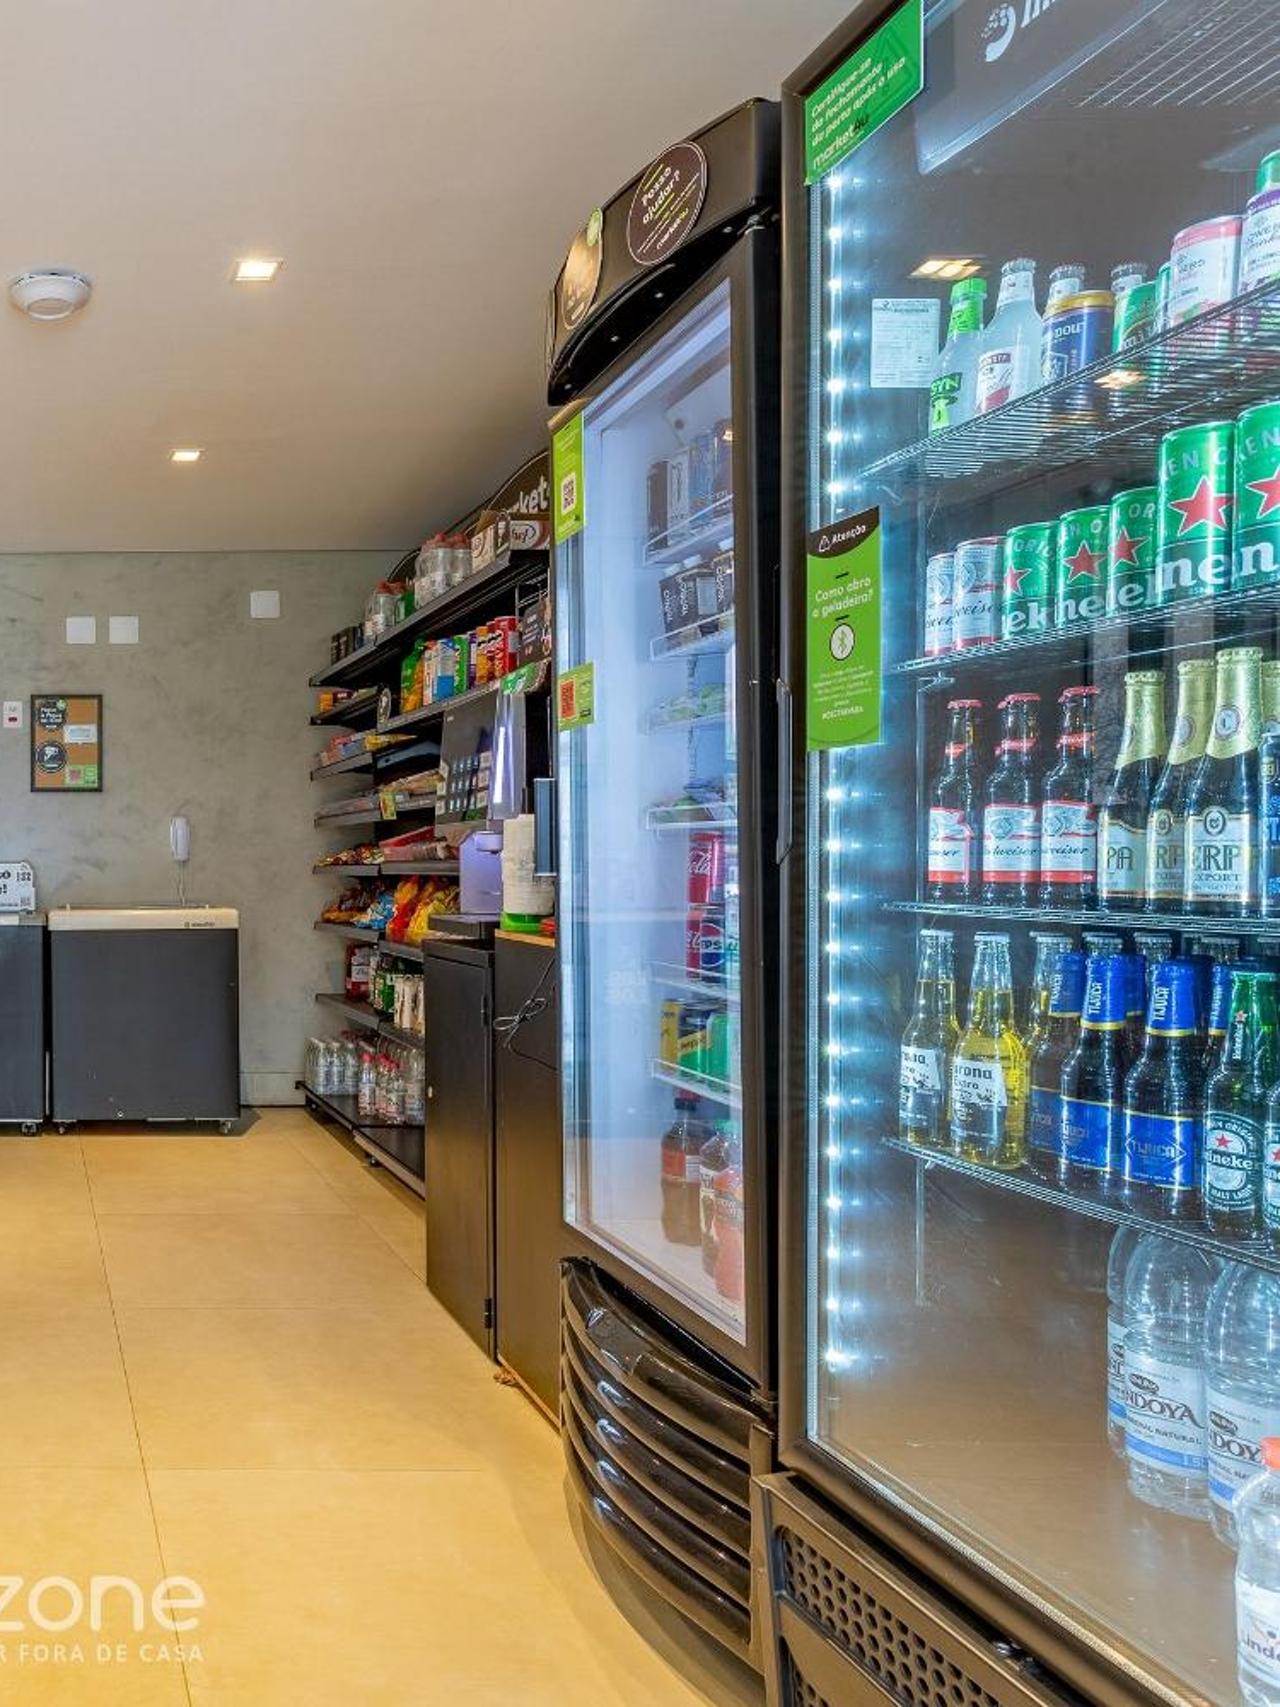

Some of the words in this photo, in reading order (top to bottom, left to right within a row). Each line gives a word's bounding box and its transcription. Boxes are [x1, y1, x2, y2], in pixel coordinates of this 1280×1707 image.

[831, 525, 867, 544] Atenção
[815, 586, 844, 602] Como
[1126, 1390, 1206, 1430] NDOYA
